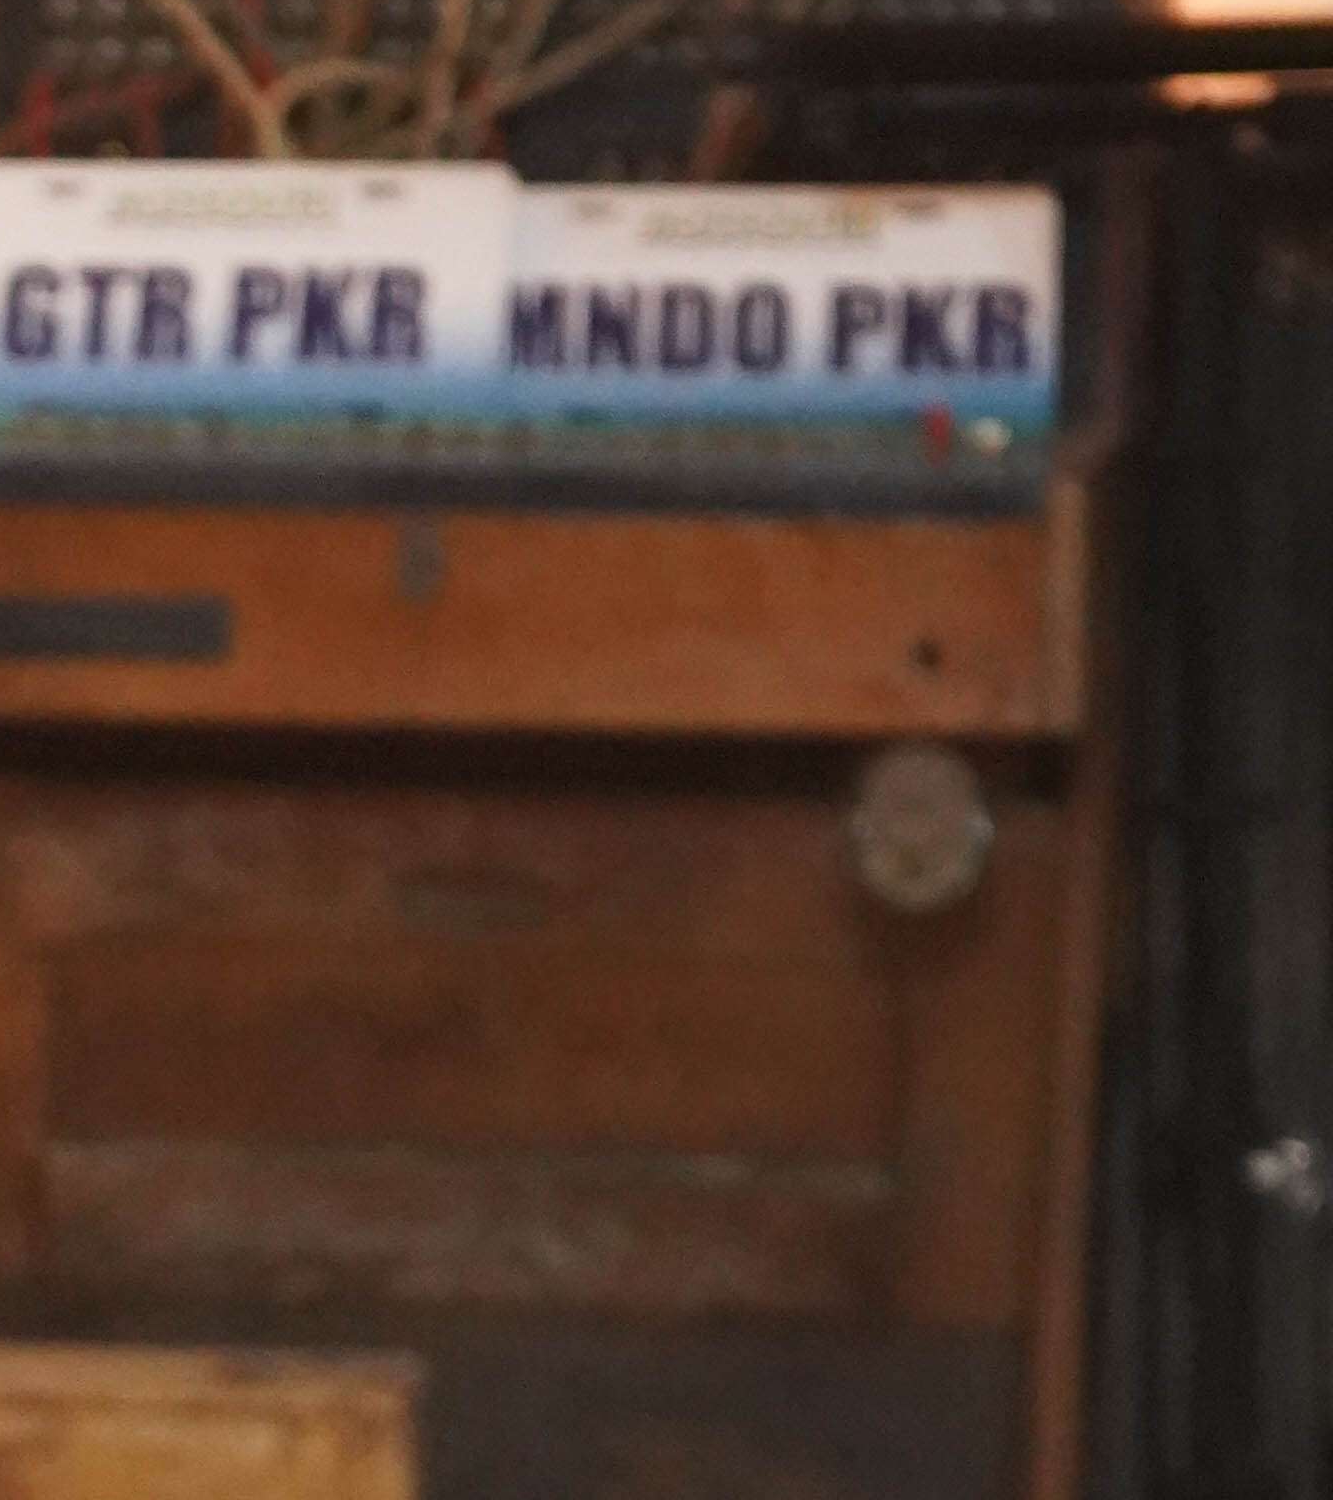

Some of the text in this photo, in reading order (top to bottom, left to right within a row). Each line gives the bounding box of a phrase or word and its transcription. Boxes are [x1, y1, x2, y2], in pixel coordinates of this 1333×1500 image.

[0, 263, 428, 366] GTR PKR
[507, 283, 1035, 375] MNDO PKR
